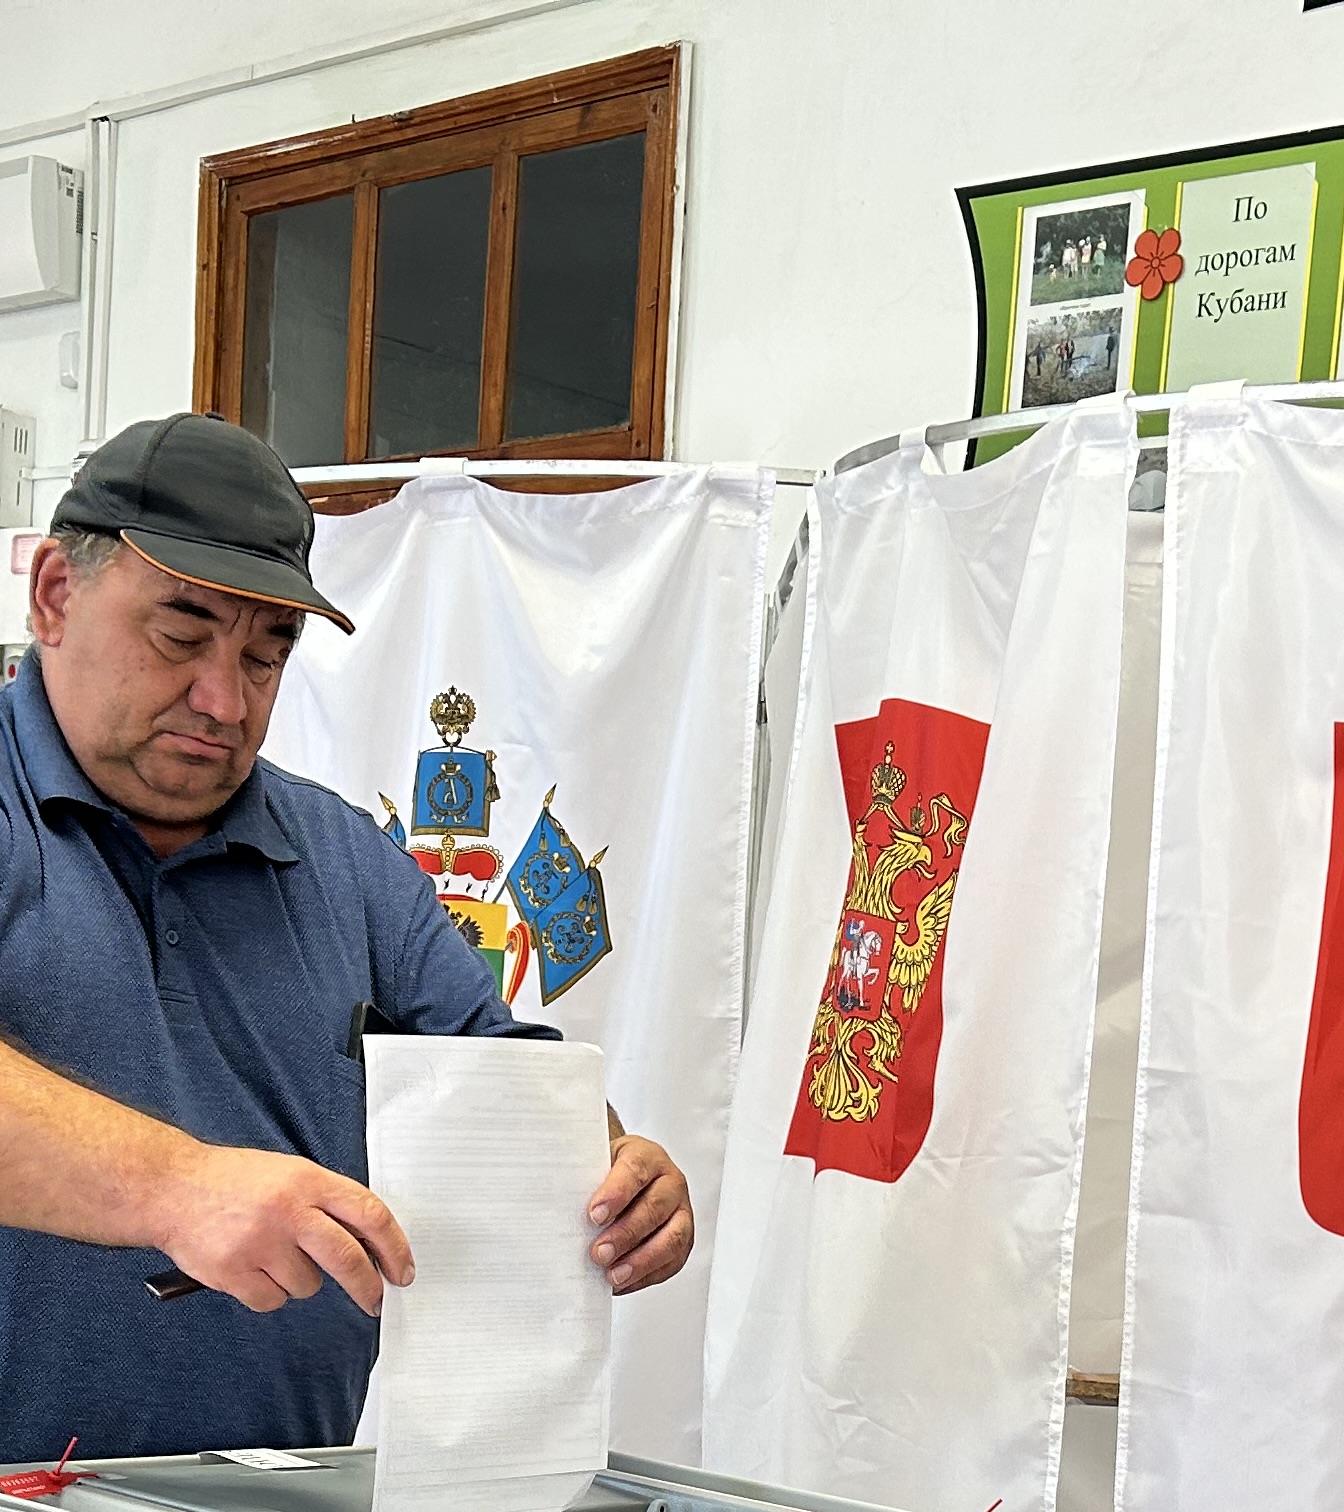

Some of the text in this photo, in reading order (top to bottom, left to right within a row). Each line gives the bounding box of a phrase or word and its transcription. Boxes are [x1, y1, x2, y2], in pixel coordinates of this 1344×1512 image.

[1231, 196, 1268, 223] По
[1194, 242, 1297, 277] дорогам
[1195, 287, 1289, 323] Кубани
